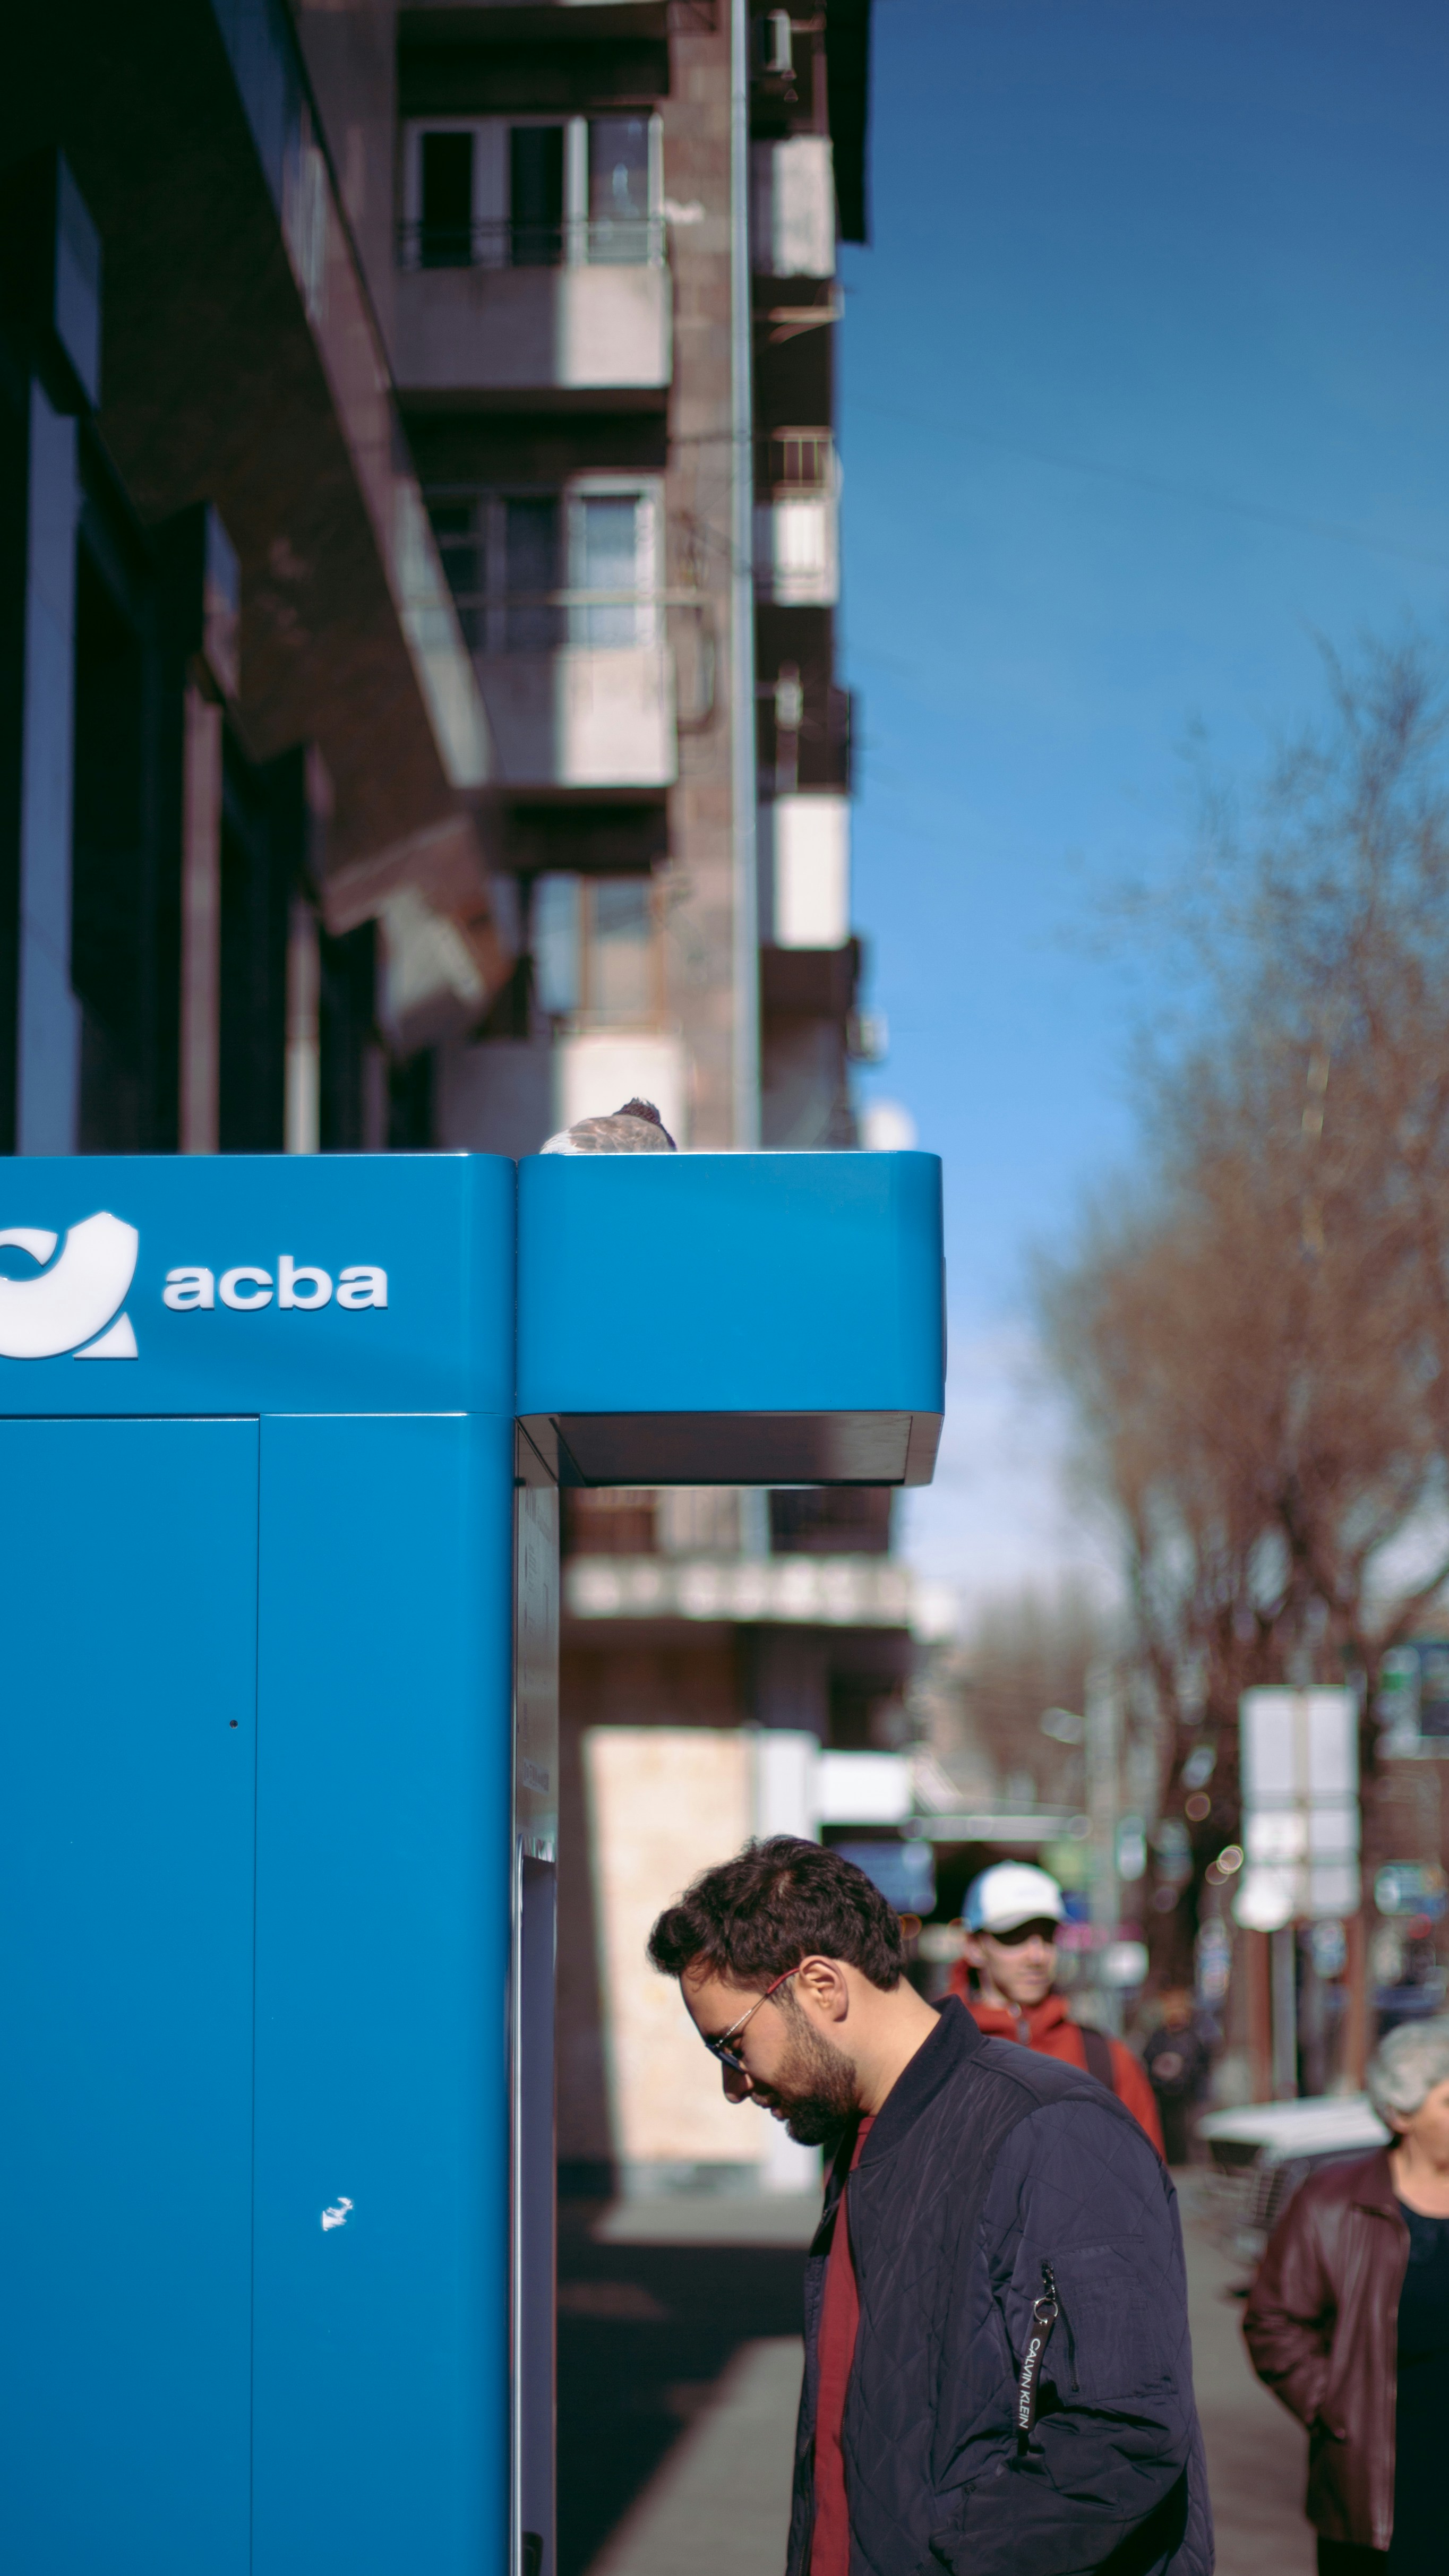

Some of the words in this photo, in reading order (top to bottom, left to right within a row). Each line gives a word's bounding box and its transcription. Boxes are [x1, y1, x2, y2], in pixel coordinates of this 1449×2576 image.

[162, 1255, 388, 1310] acba
[1021, 2338, 1041, 2388] CALVIN
[1018, 2390, 1030, 2429] KLEIN
